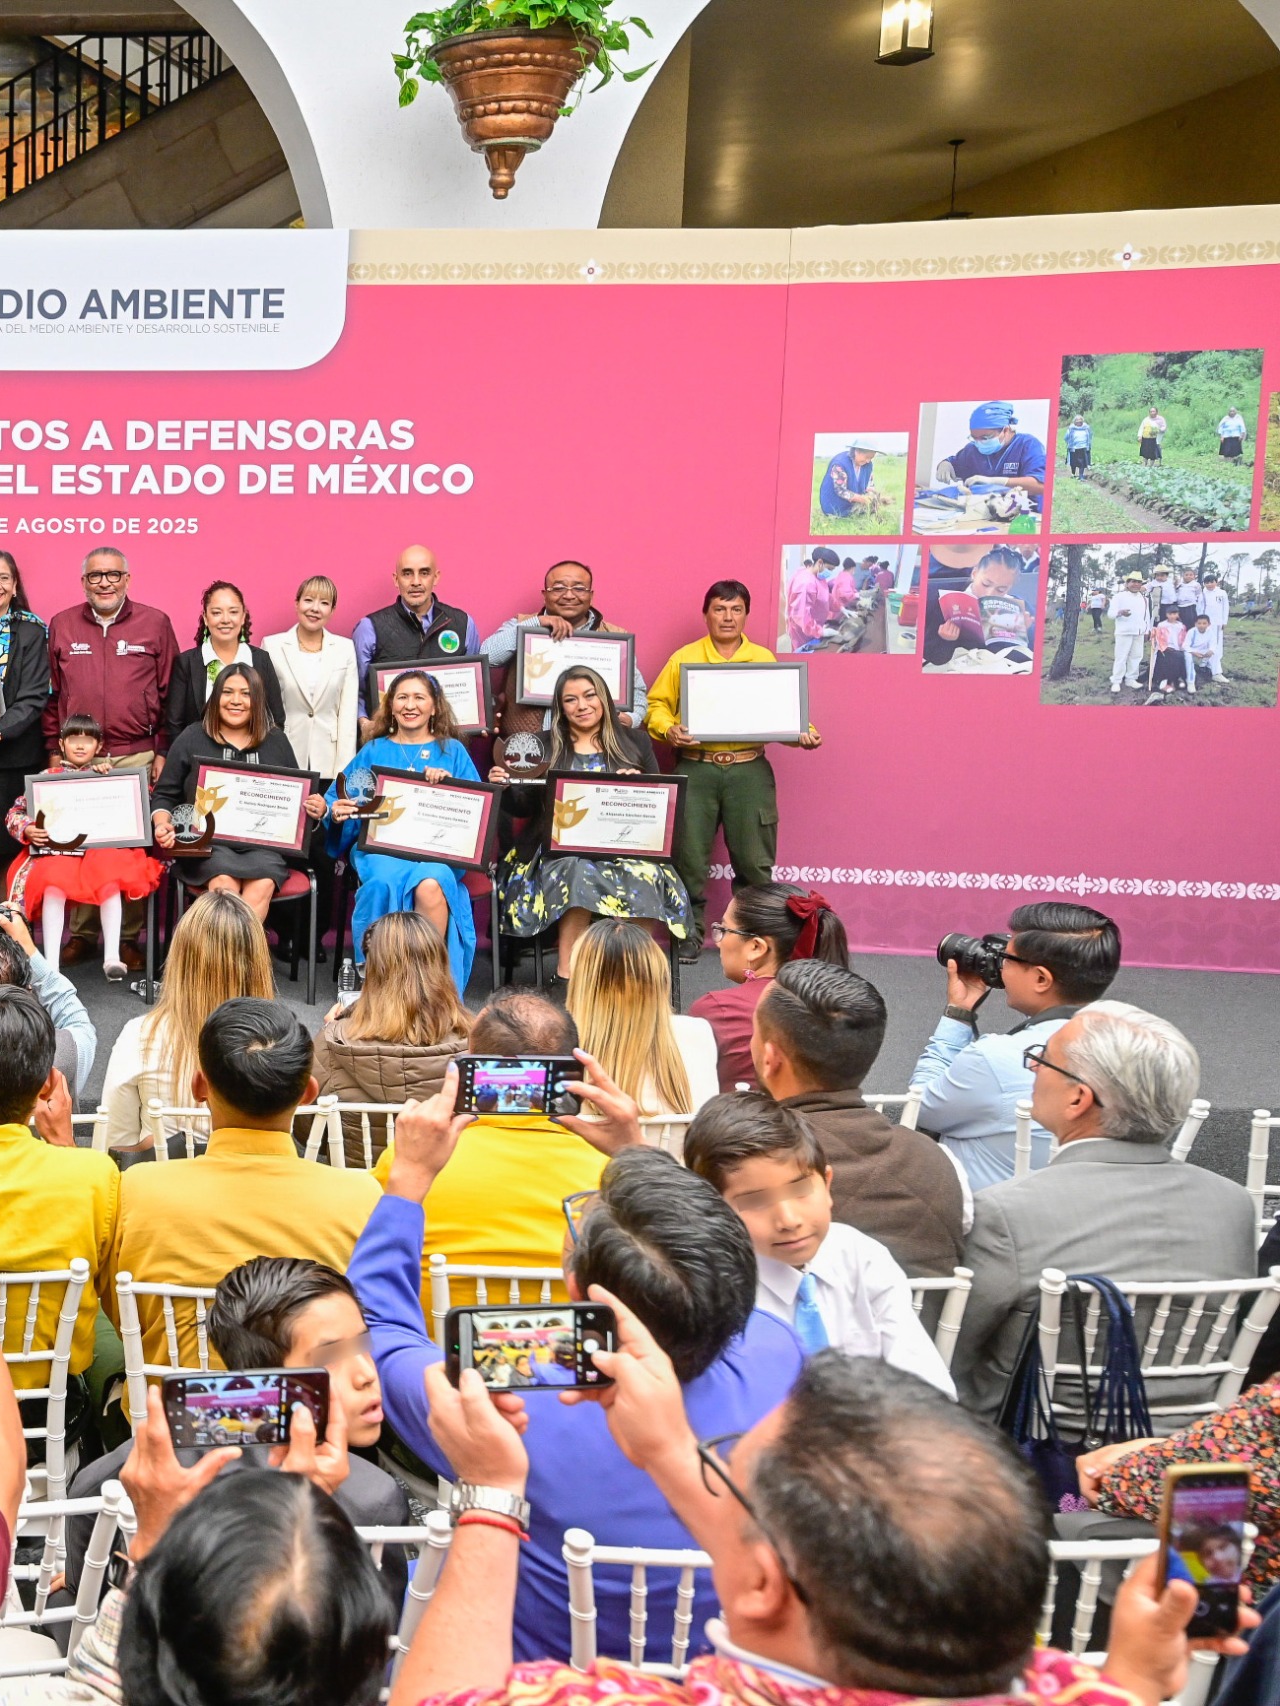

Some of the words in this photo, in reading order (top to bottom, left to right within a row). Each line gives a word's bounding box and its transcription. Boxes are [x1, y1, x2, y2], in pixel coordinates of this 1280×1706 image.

[78, 289, 285, 318] AMBIENTE
[5, 324, 27, 334] DEL
[29, 324, 64, 334] MEDIO
[66, 324, 123, 334] AMBIENTE
[125, 324, 133, 334] Y
[136, 324, 211, 334] DESARROLLO
[213, 324, 280, 334] SOSTENIBLE
[80, 420, 114, 451] A
[125, 419, 416, 451] DEFENSORAS
[51, 464, 226, 496] ESTADO
[238, 464, 296, 495] DE
[307, 456, 475, 495] MÉXICO
[14, 517, 106, 535] AGOSTO
[112, 517, 141, 535] DE
[146, 517, 199, 535] 2025
[239, 791, 292, 802] RECONOCIMIENTO
[418, 802, 472, 815] RECONOCIMIENTO
[601, 801, 657, 809] RECONOCIMIENTO
